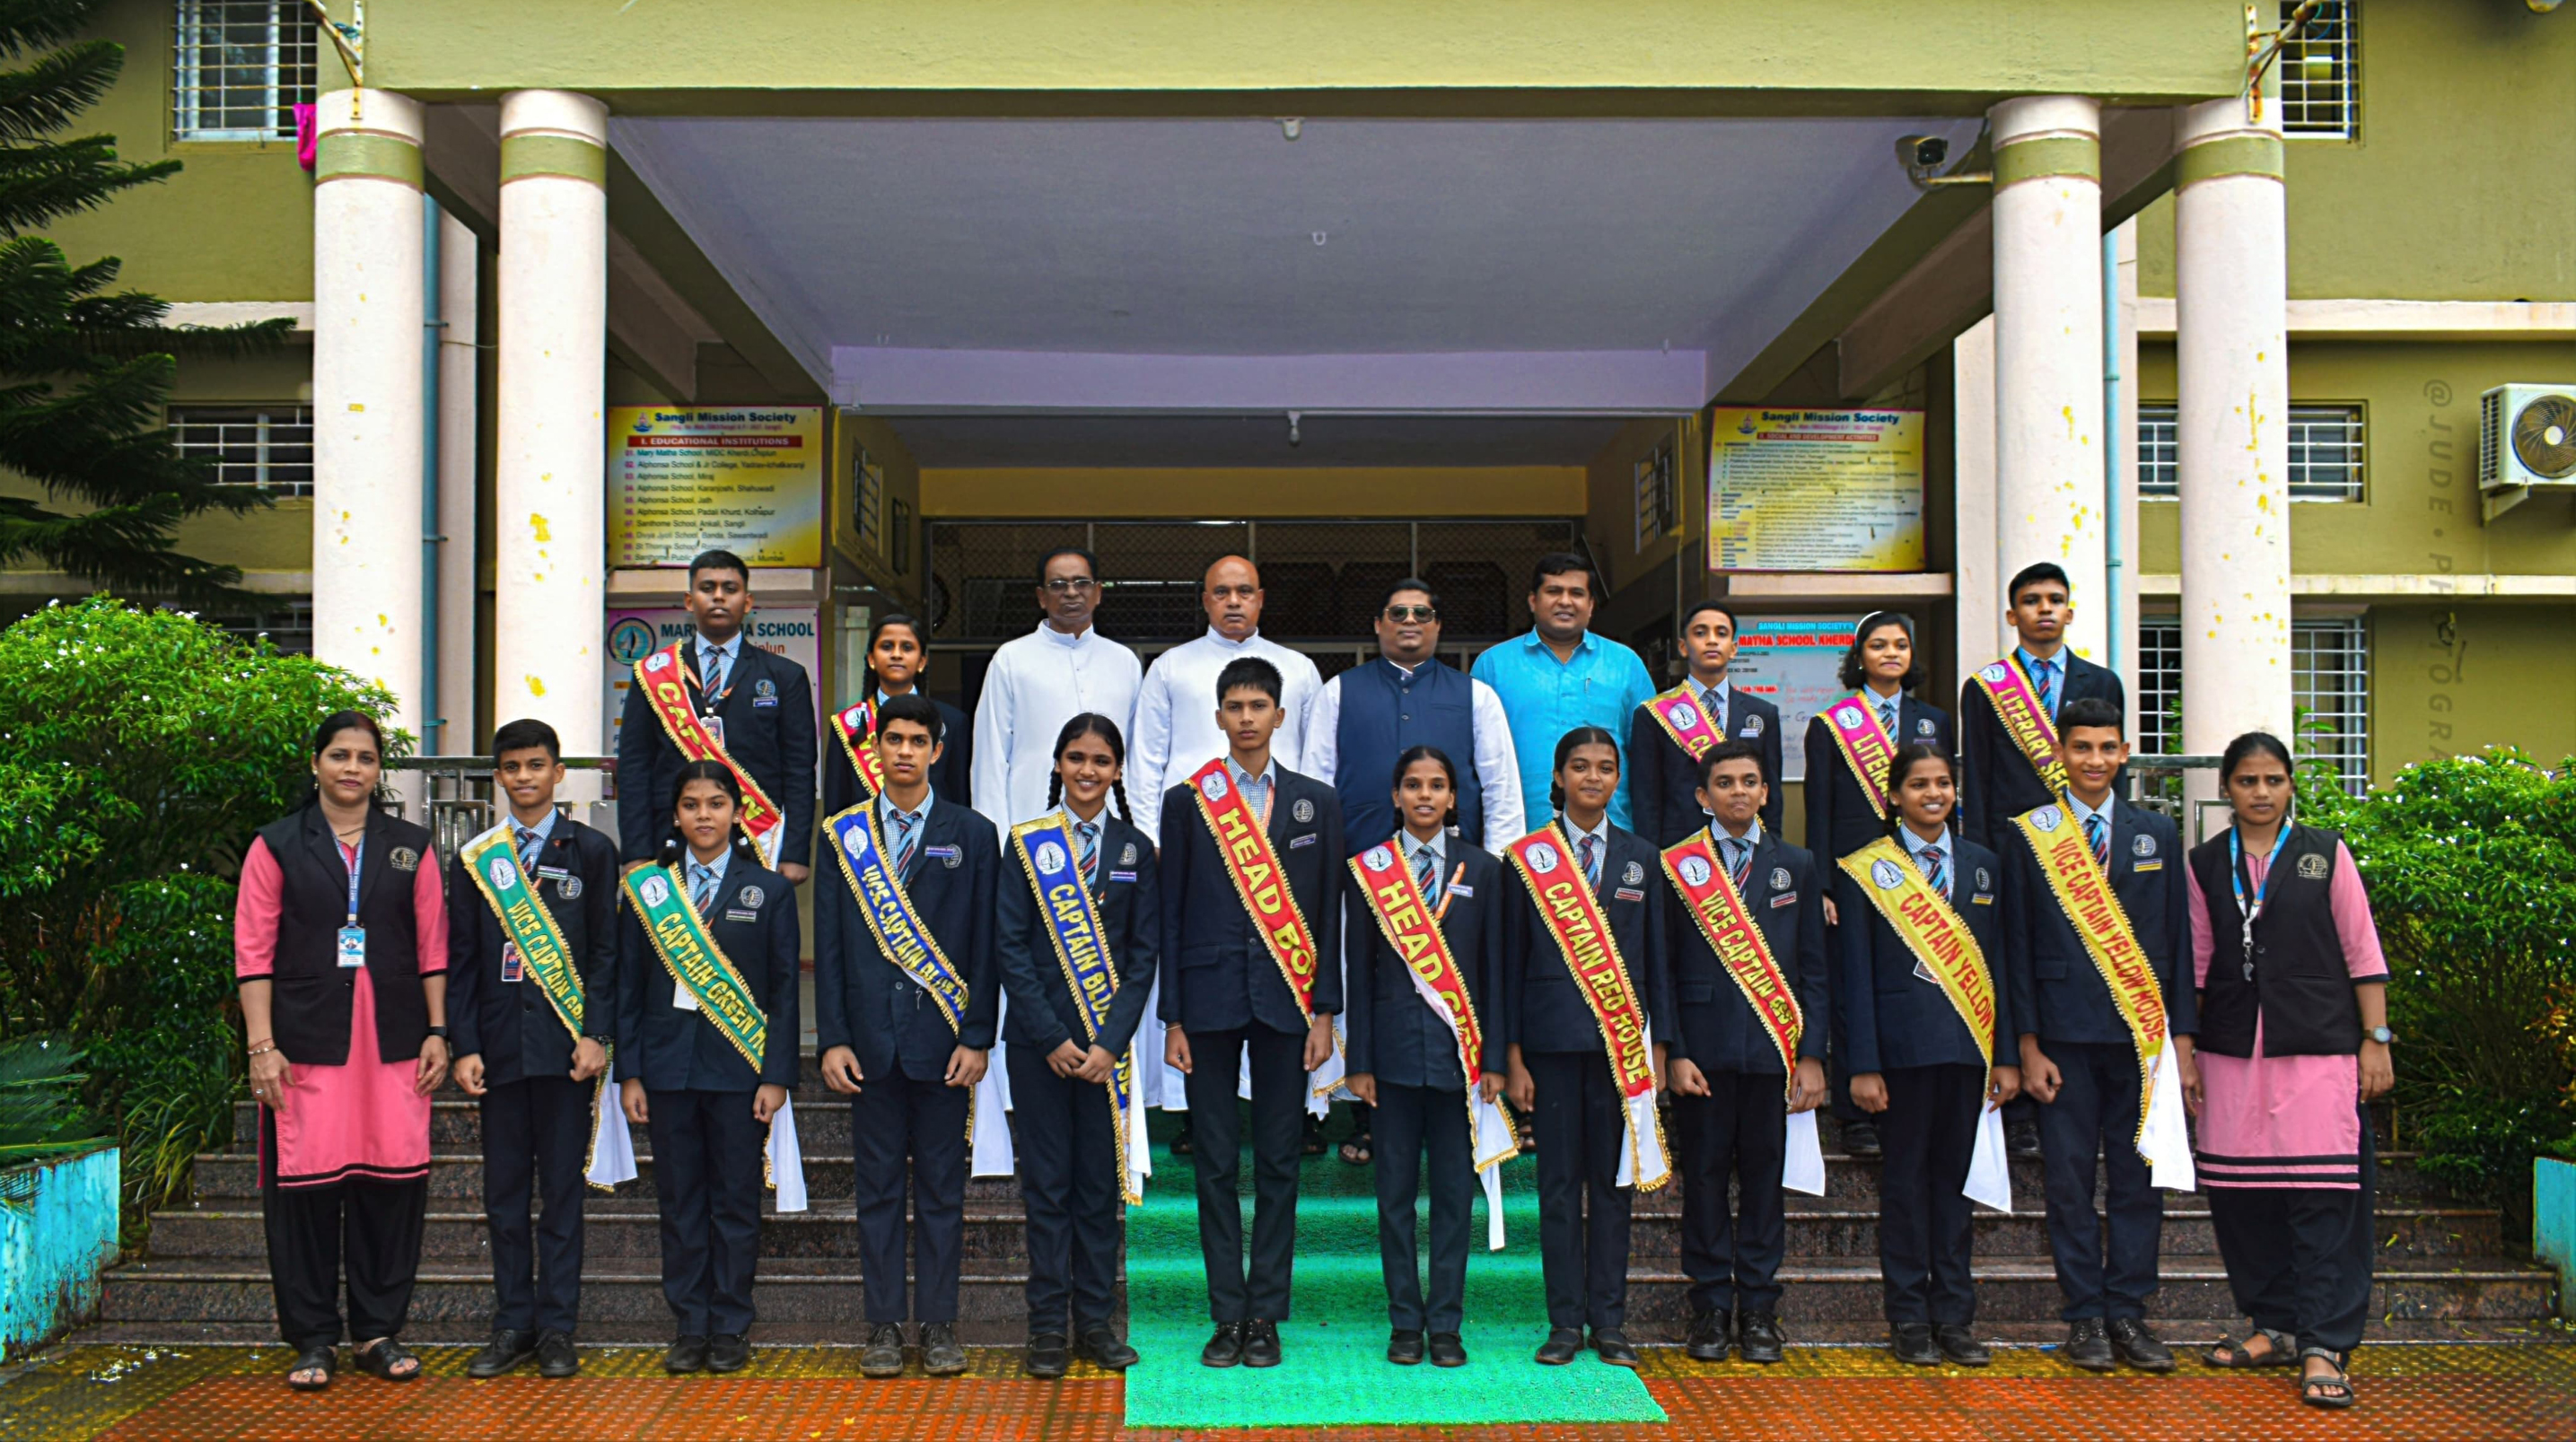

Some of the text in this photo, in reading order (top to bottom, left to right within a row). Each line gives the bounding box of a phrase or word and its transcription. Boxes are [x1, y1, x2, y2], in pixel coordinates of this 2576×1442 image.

[650, 437, 718, 445] EDUCATIONAL
[721, 437, 789, 445] INSTITUTIONS
[655, 412, 796, 424] Sangli Mission Society
[1761, 411, 1899, 425] Sangli Mission Society
[757, 623, 815, 637] SCHOOL
[1739, 635, 1774, 646] MATHA
[1776, 634, 1816, 646] SCHOOL
[1758, 622, 1784, 630] SANGLI
[1786, 622, 1816, 630] MISSION
[1996, 686, 2052, 761] LITERARY
[1218, 808, 1282, 914] HEAD
[507, 897, 541, 937] VICE
[526, 933, 571, 999] CAPTAIN
[860, 864, 890, 907] VICE
[878, 901, 928, 973] CAPTAIN
[1049, 883, 1101, 972] CAPTAIN
[1378, 879, 1444, 983] HEAD
[1698, 889, 1736, 933] VICE
[1719, 928, 1776, 998] CAPTAIN
[1899, 893, 1994, 1029] CAPTAIN YELLOW
[2049, 835, 2166, 1043] VICE CAPTAIN YELLOW HOUSE
[656, 913, 717, 987] CAPTAIN
[707, 981, 756, 1035] GREEN
[1545, 881, 1650, 1084] CAPTAIN RED HOUSE
